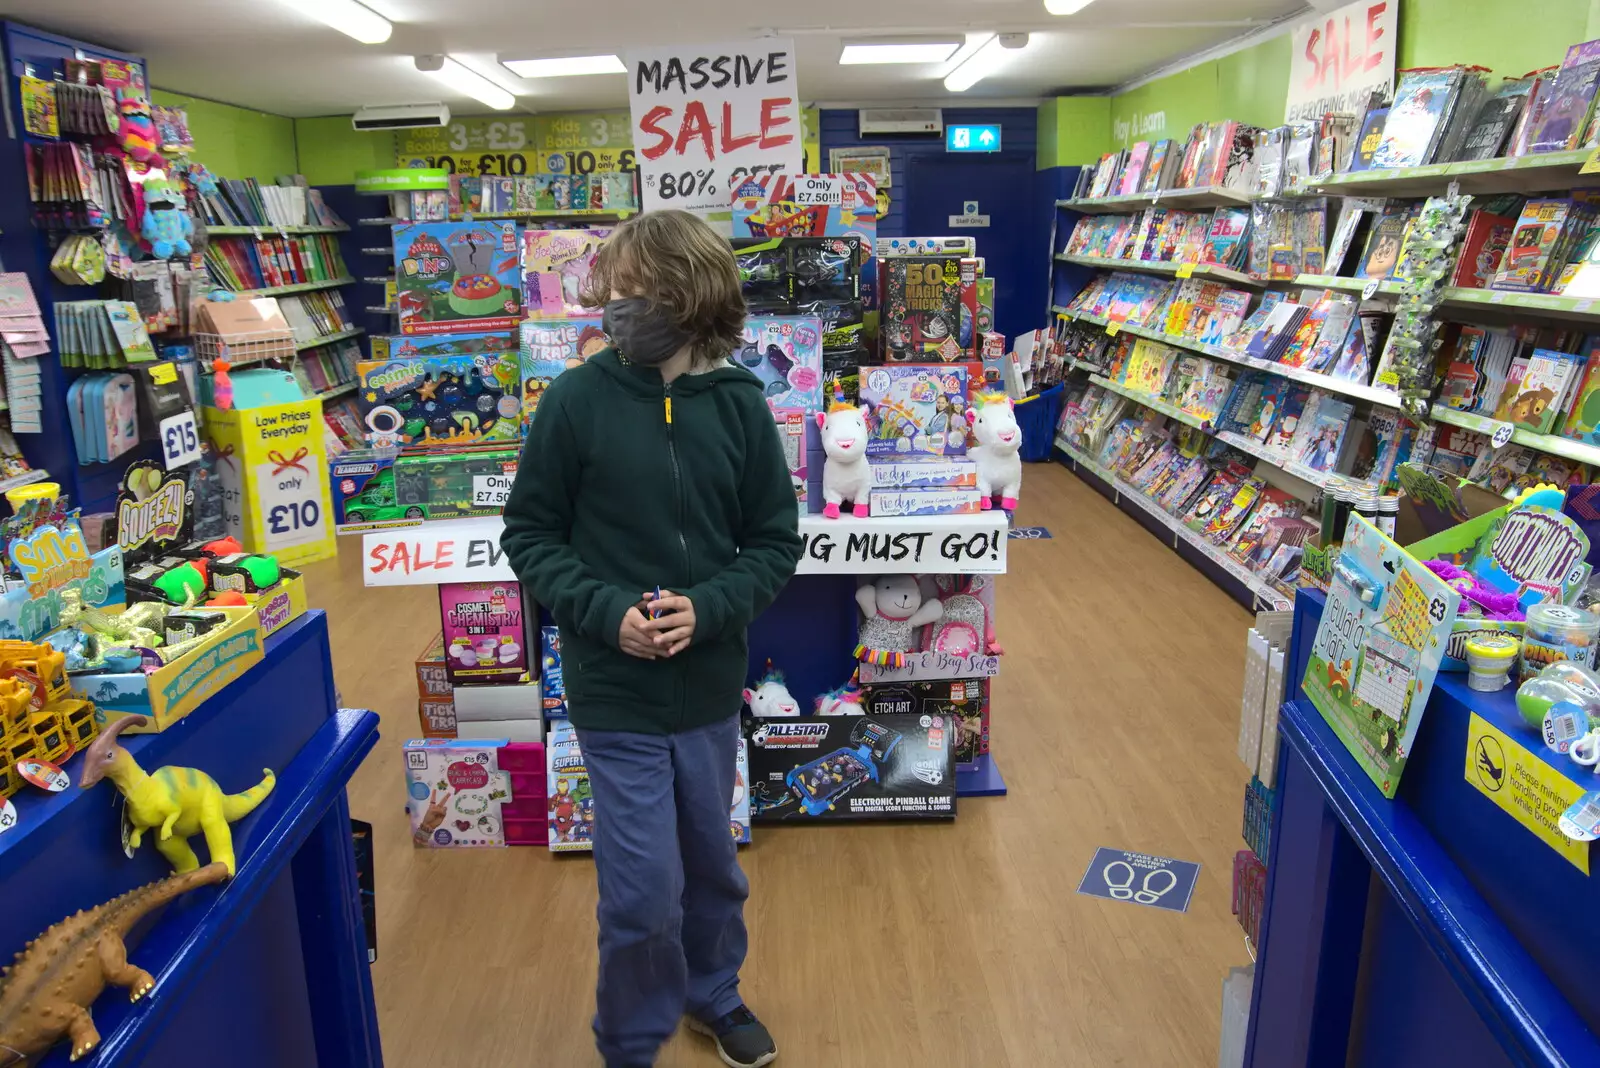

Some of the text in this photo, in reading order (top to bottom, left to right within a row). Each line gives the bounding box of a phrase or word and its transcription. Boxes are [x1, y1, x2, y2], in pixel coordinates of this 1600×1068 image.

[1305, 2, 1387, 91] SALE
[636, 52, 788, 95] MASSIVE
[1289, 95, 1346, 121] EVERYTHING
[411, 121, 525, 151] Kids 3 £5
[551, 118, 609, 146] Kids 3
[639, 97, 794, 162] SALE
[1113, 110, 1166, 147] Play & Learn
[405, 138, 449, 153] Books
[545, 134, 588, 148] Books
[426, 153, 527, 176] 10 for £10
[457, 166, 475, 175] only
[548, 157, 566, 169] OR
[566, 151, 597, 175] 10
[600, 153, 612, 161] for
[597, 161, 615, 170] only
[645, 174, 655, 182] UP
[658, 168, 717, 200] 80%
[806, 180, 832, 191] Only
[798, 192, 840, 203] £7.50!!!
[402, 257, 451, 277] DINO
[906, 263, 944, 285] 50
[945, 265, 958, 273] £10
[905, 284, 944, 298] MAGIC
[906, 298, 943, 310] TRICKS
[529, 344, 573, 361] TRAP
[368, 361, 426, 389] cosmic
[255, 410, 312, 428] Low Prices
[166, 420, 197, 460] £15
[261, 424, 310, 440] Everyday
[1493, 426, 1512, 443] £3
[336, 464, 377, 477] TEAMSTERZ
[889, 466, 911, 486] dye
[278, 477, 303, 491] only
[486, 477, 515, 489] Only
[894, 494, 917, 514] dye
[121, 484, 182, 548] SQUEEZY
[267, 499, 320, 534] £10
[373, 520, 423, 529] TRANSPORTER
[845, 529, 1000, 563] MUST GO!
[14, 531, 88, 583] Sand
[370, 540, 455, 575] SALE
[457, 602, 491, 613] COSMETI
[1428, 597, 1447, 622] £3
[447, 610, 521, 627] CHEMISTRY
[1523, 644, 1570, 664] DINO
[921, 653, 931, 668] &
[937, 652, 962, 676] Bag
[874, 701, 912, 714] ETCH ART
[768, 725, 830, 736] ALL-STAR
[1544, 719, 1556, 745] £1.50
[410, 754, 425, 764] GL
[464, 756, 476, 764] £15
[554, 758, 579, 770] SUPER
[916, 759, 941, 770] GOAL!
[1515, 763, 1540, 790] Please
[1509, 774, 1543, 810] handling
[850, 796, 951, 807] ELECTRONIC PINBALL GAME
[901, 804, 927, 812] FUNCTION
[1513, 793, 1533, 816] while
[1123, 852, 1173, 865] PLEASE STAY
[1131, 862, 1158, 870] APART
[1134, 858, 1166, 869] METRES
